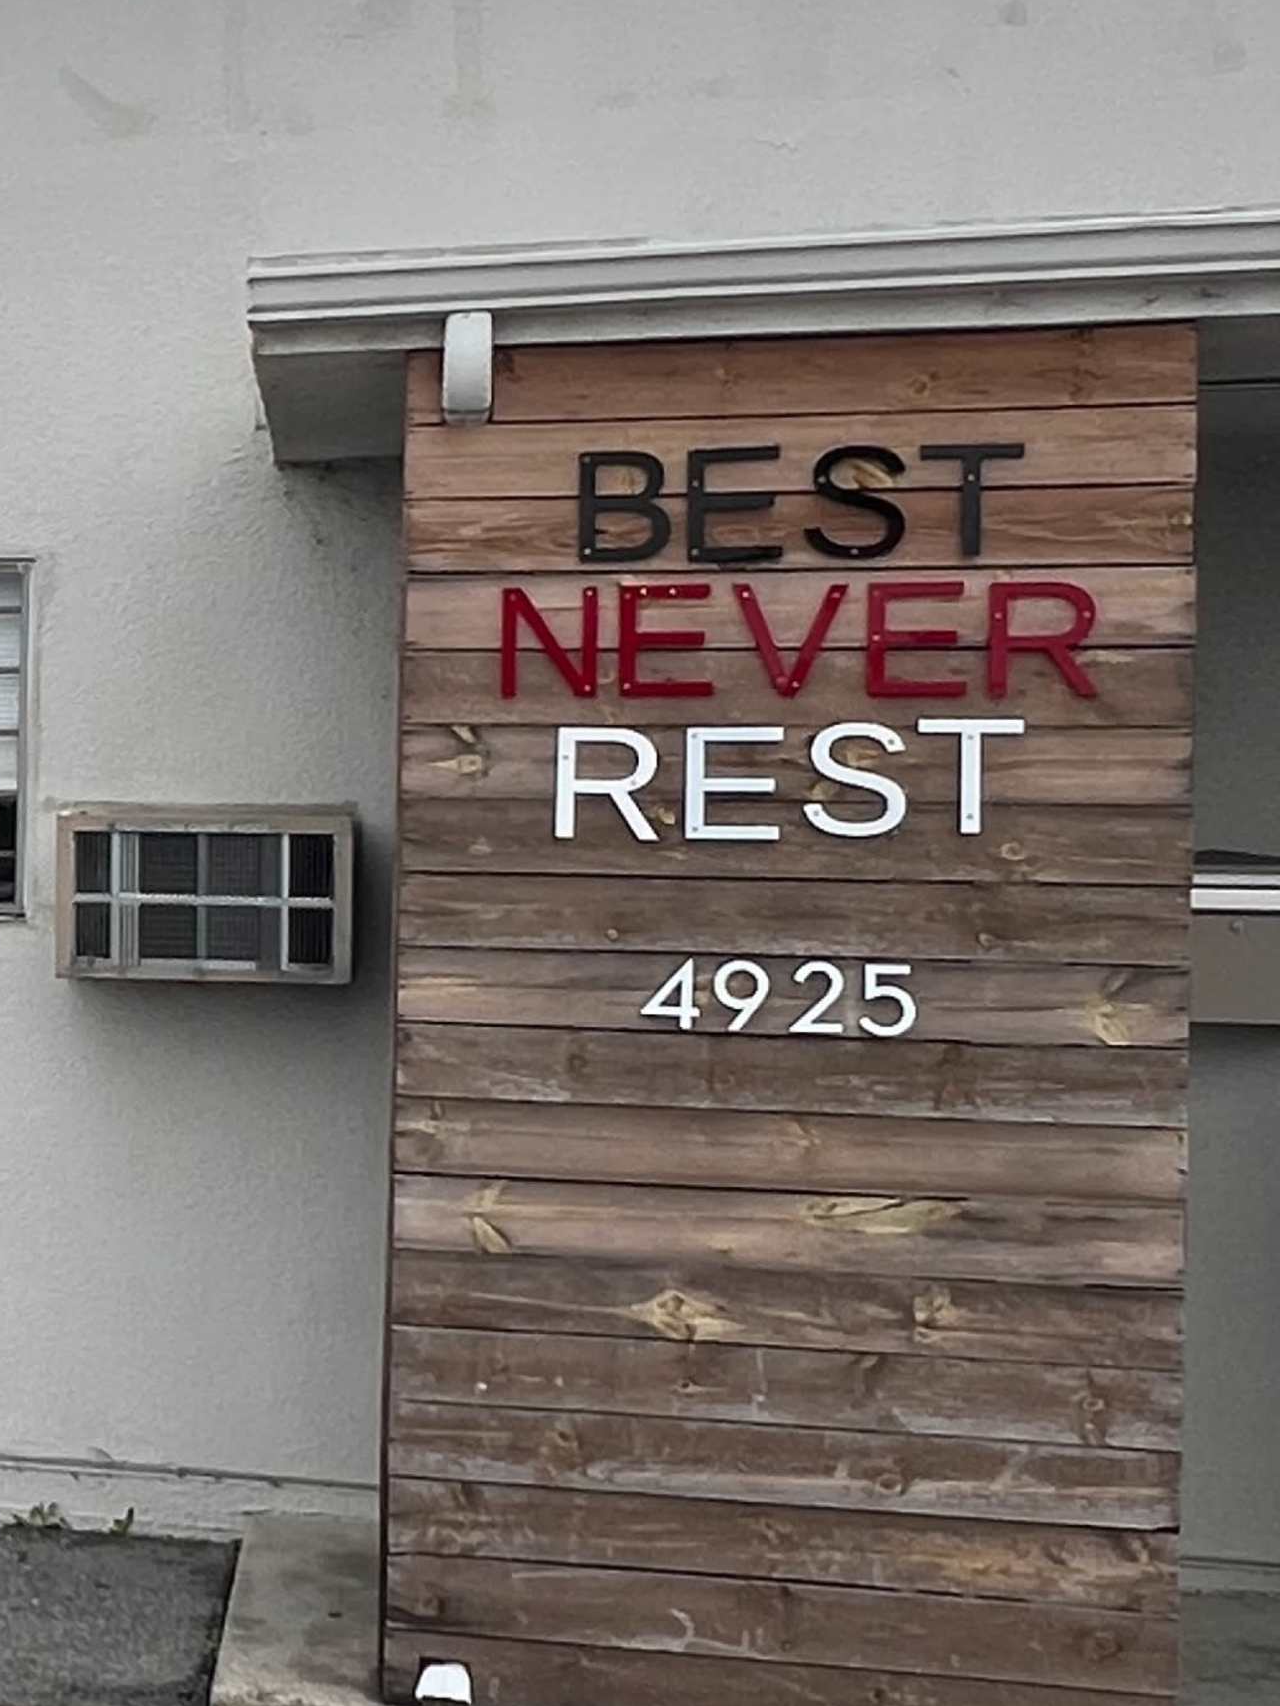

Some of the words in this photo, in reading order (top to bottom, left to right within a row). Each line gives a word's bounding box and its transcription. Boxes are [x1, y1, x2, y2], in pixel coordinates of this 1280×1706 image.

[578, 442, 1026, 564] BEST
[498, 580, 1098, 700] NEVER
[553, 717, 1026, 842] REST
[640, 956, 919, 1038] 4925
